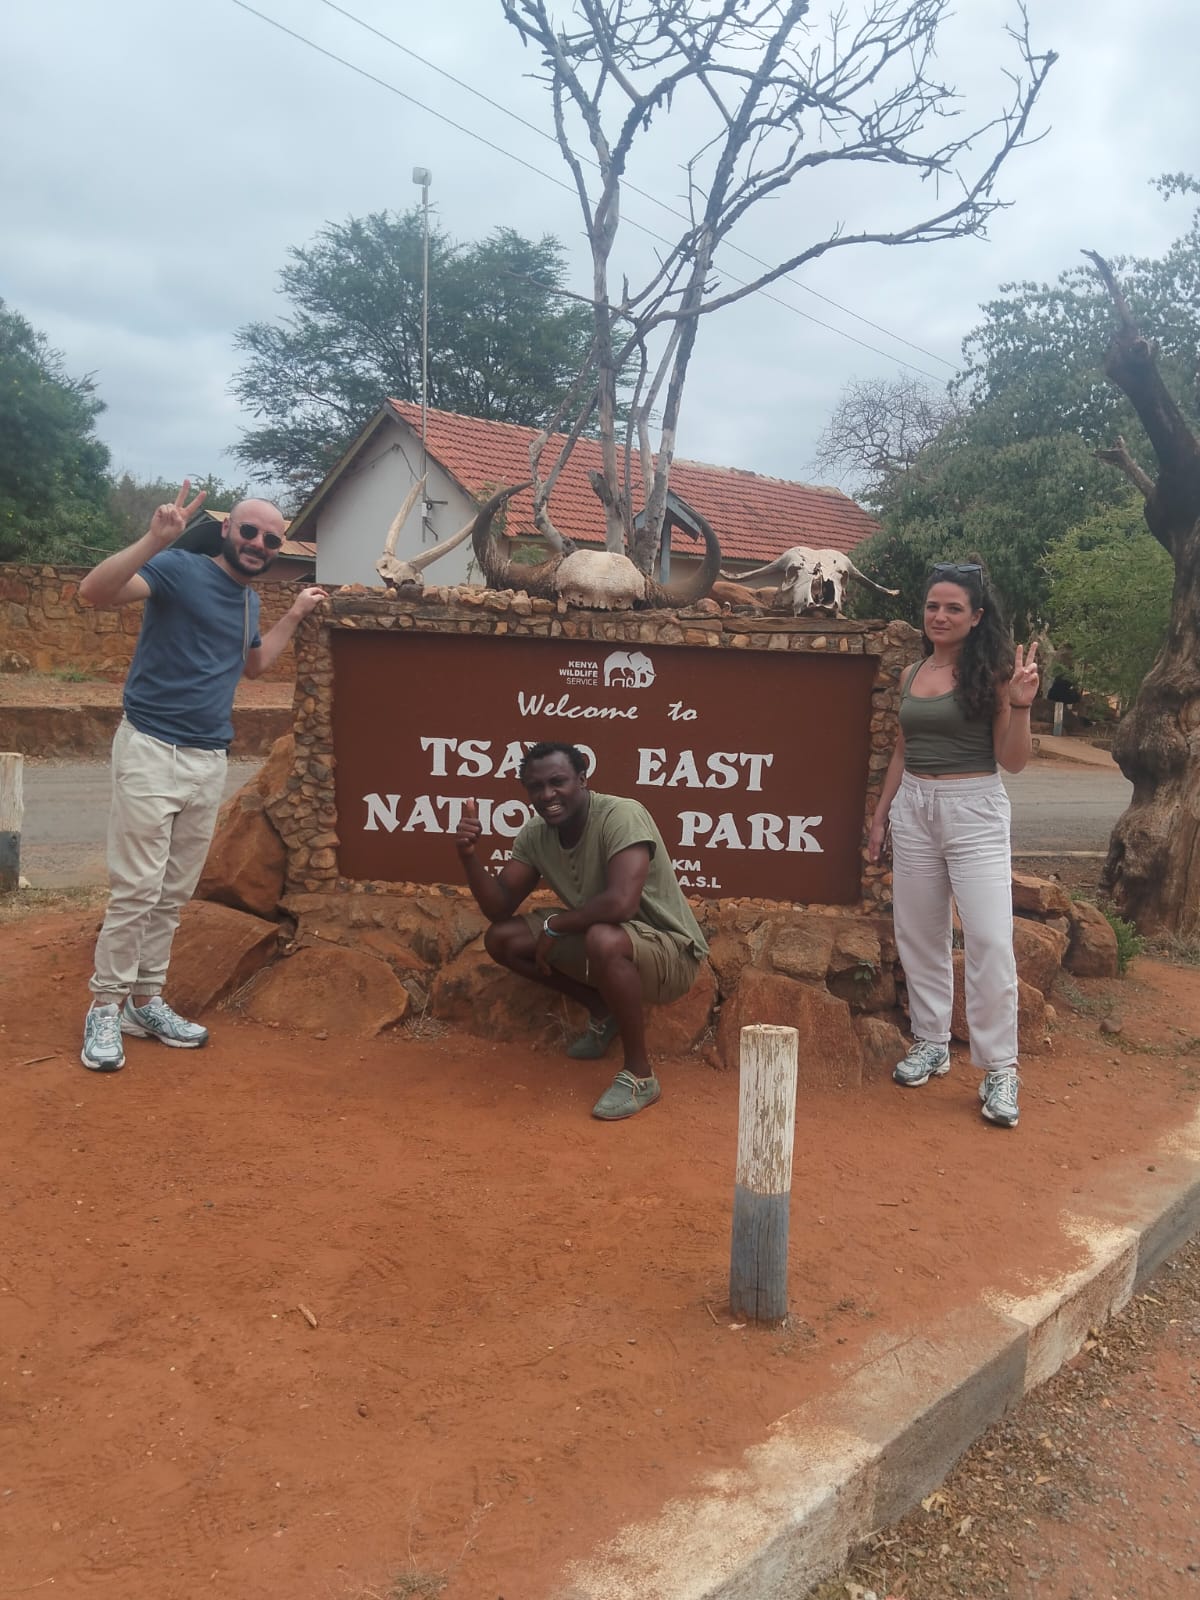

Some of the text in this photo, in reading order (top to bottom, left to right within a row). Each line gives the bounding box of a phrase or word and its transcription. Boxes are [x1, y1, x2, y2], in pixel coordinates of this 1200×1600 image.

[568, 660, 599, 669] KENYA
[559, 668, 599, 678] WILDLIFE
[566, 677, 599, 686] SERVICE
[518, 691, 698, 721] Welcome to
[636, 748, 774, 791] EAST
[677, 811, 824, 853] PARK
[671, 859, 701, 872] KM
